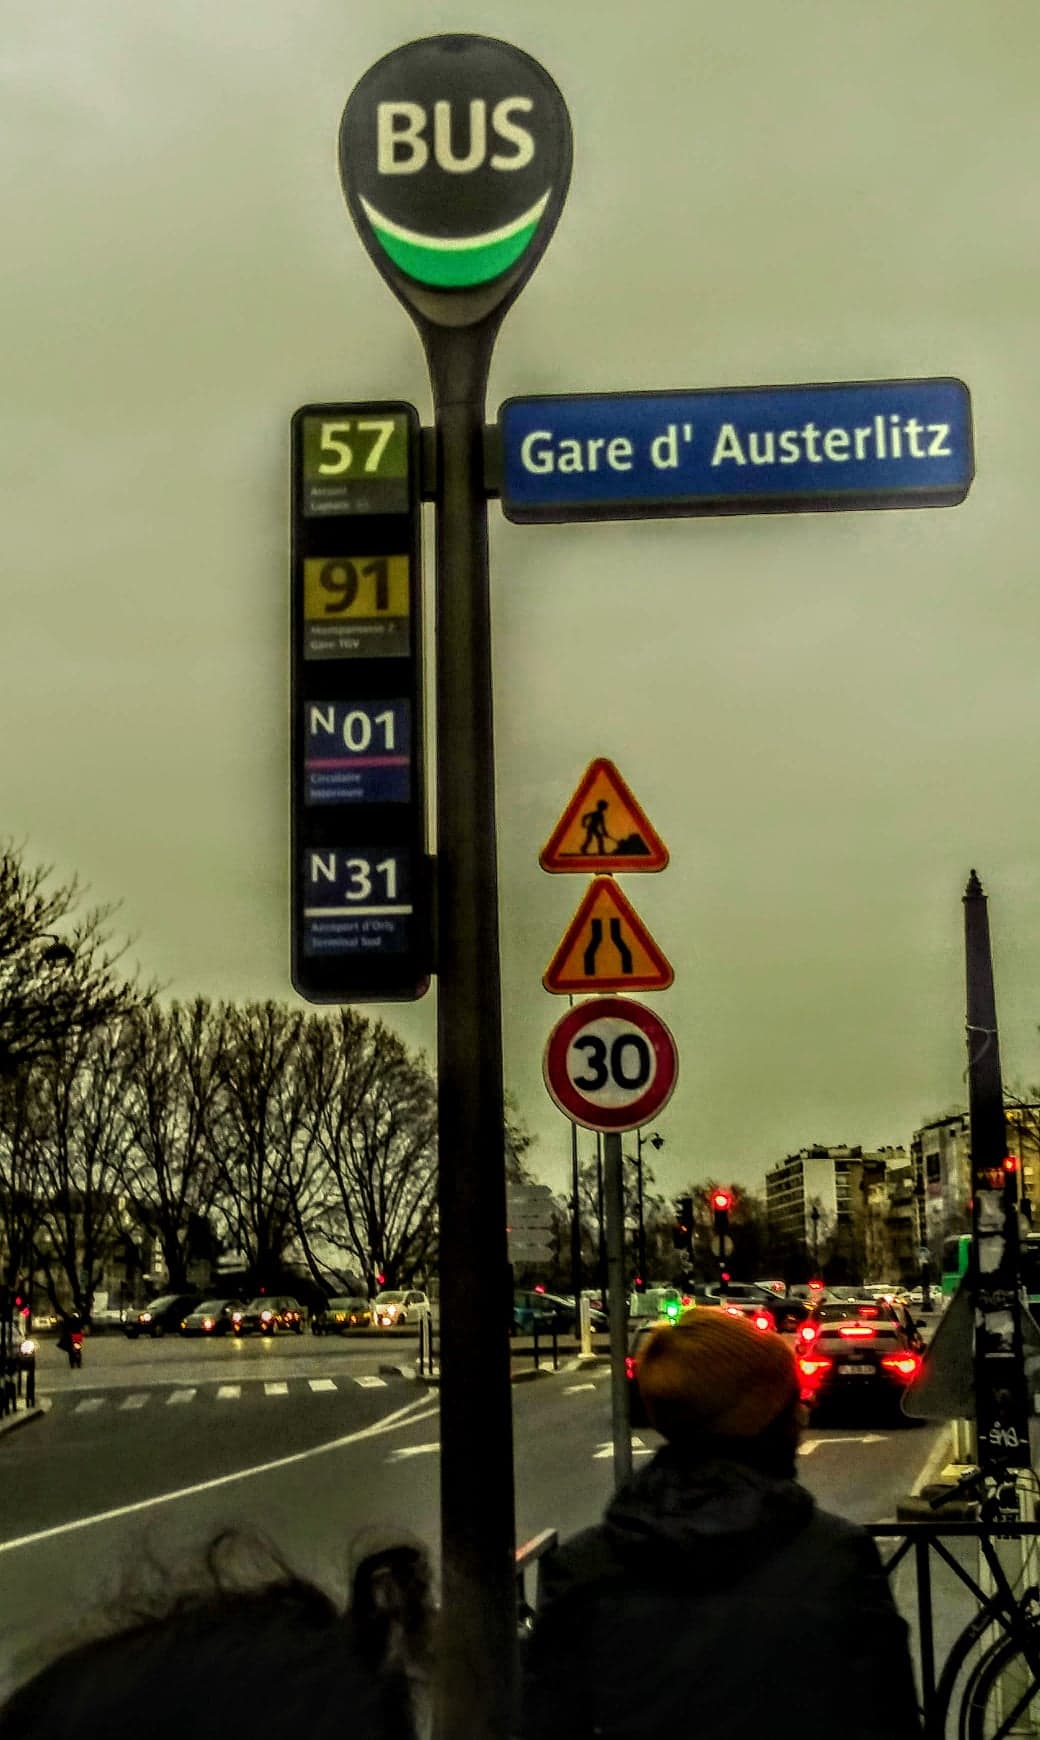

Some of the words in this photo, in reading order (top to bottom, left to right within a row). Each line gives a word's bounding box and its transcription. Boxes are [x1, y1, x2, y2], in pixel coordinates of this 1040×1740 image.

[377, 97, 535, 174] BUS
[318, 421, 395, 475] 57
[520, 430, 633, 475] Gare
[650, 424, 692, 469] d'
[711, 415, 951, 467] Austerlitz
[319, 559, 389, 614] 91
[573, 1033, 651, 1091] 30
